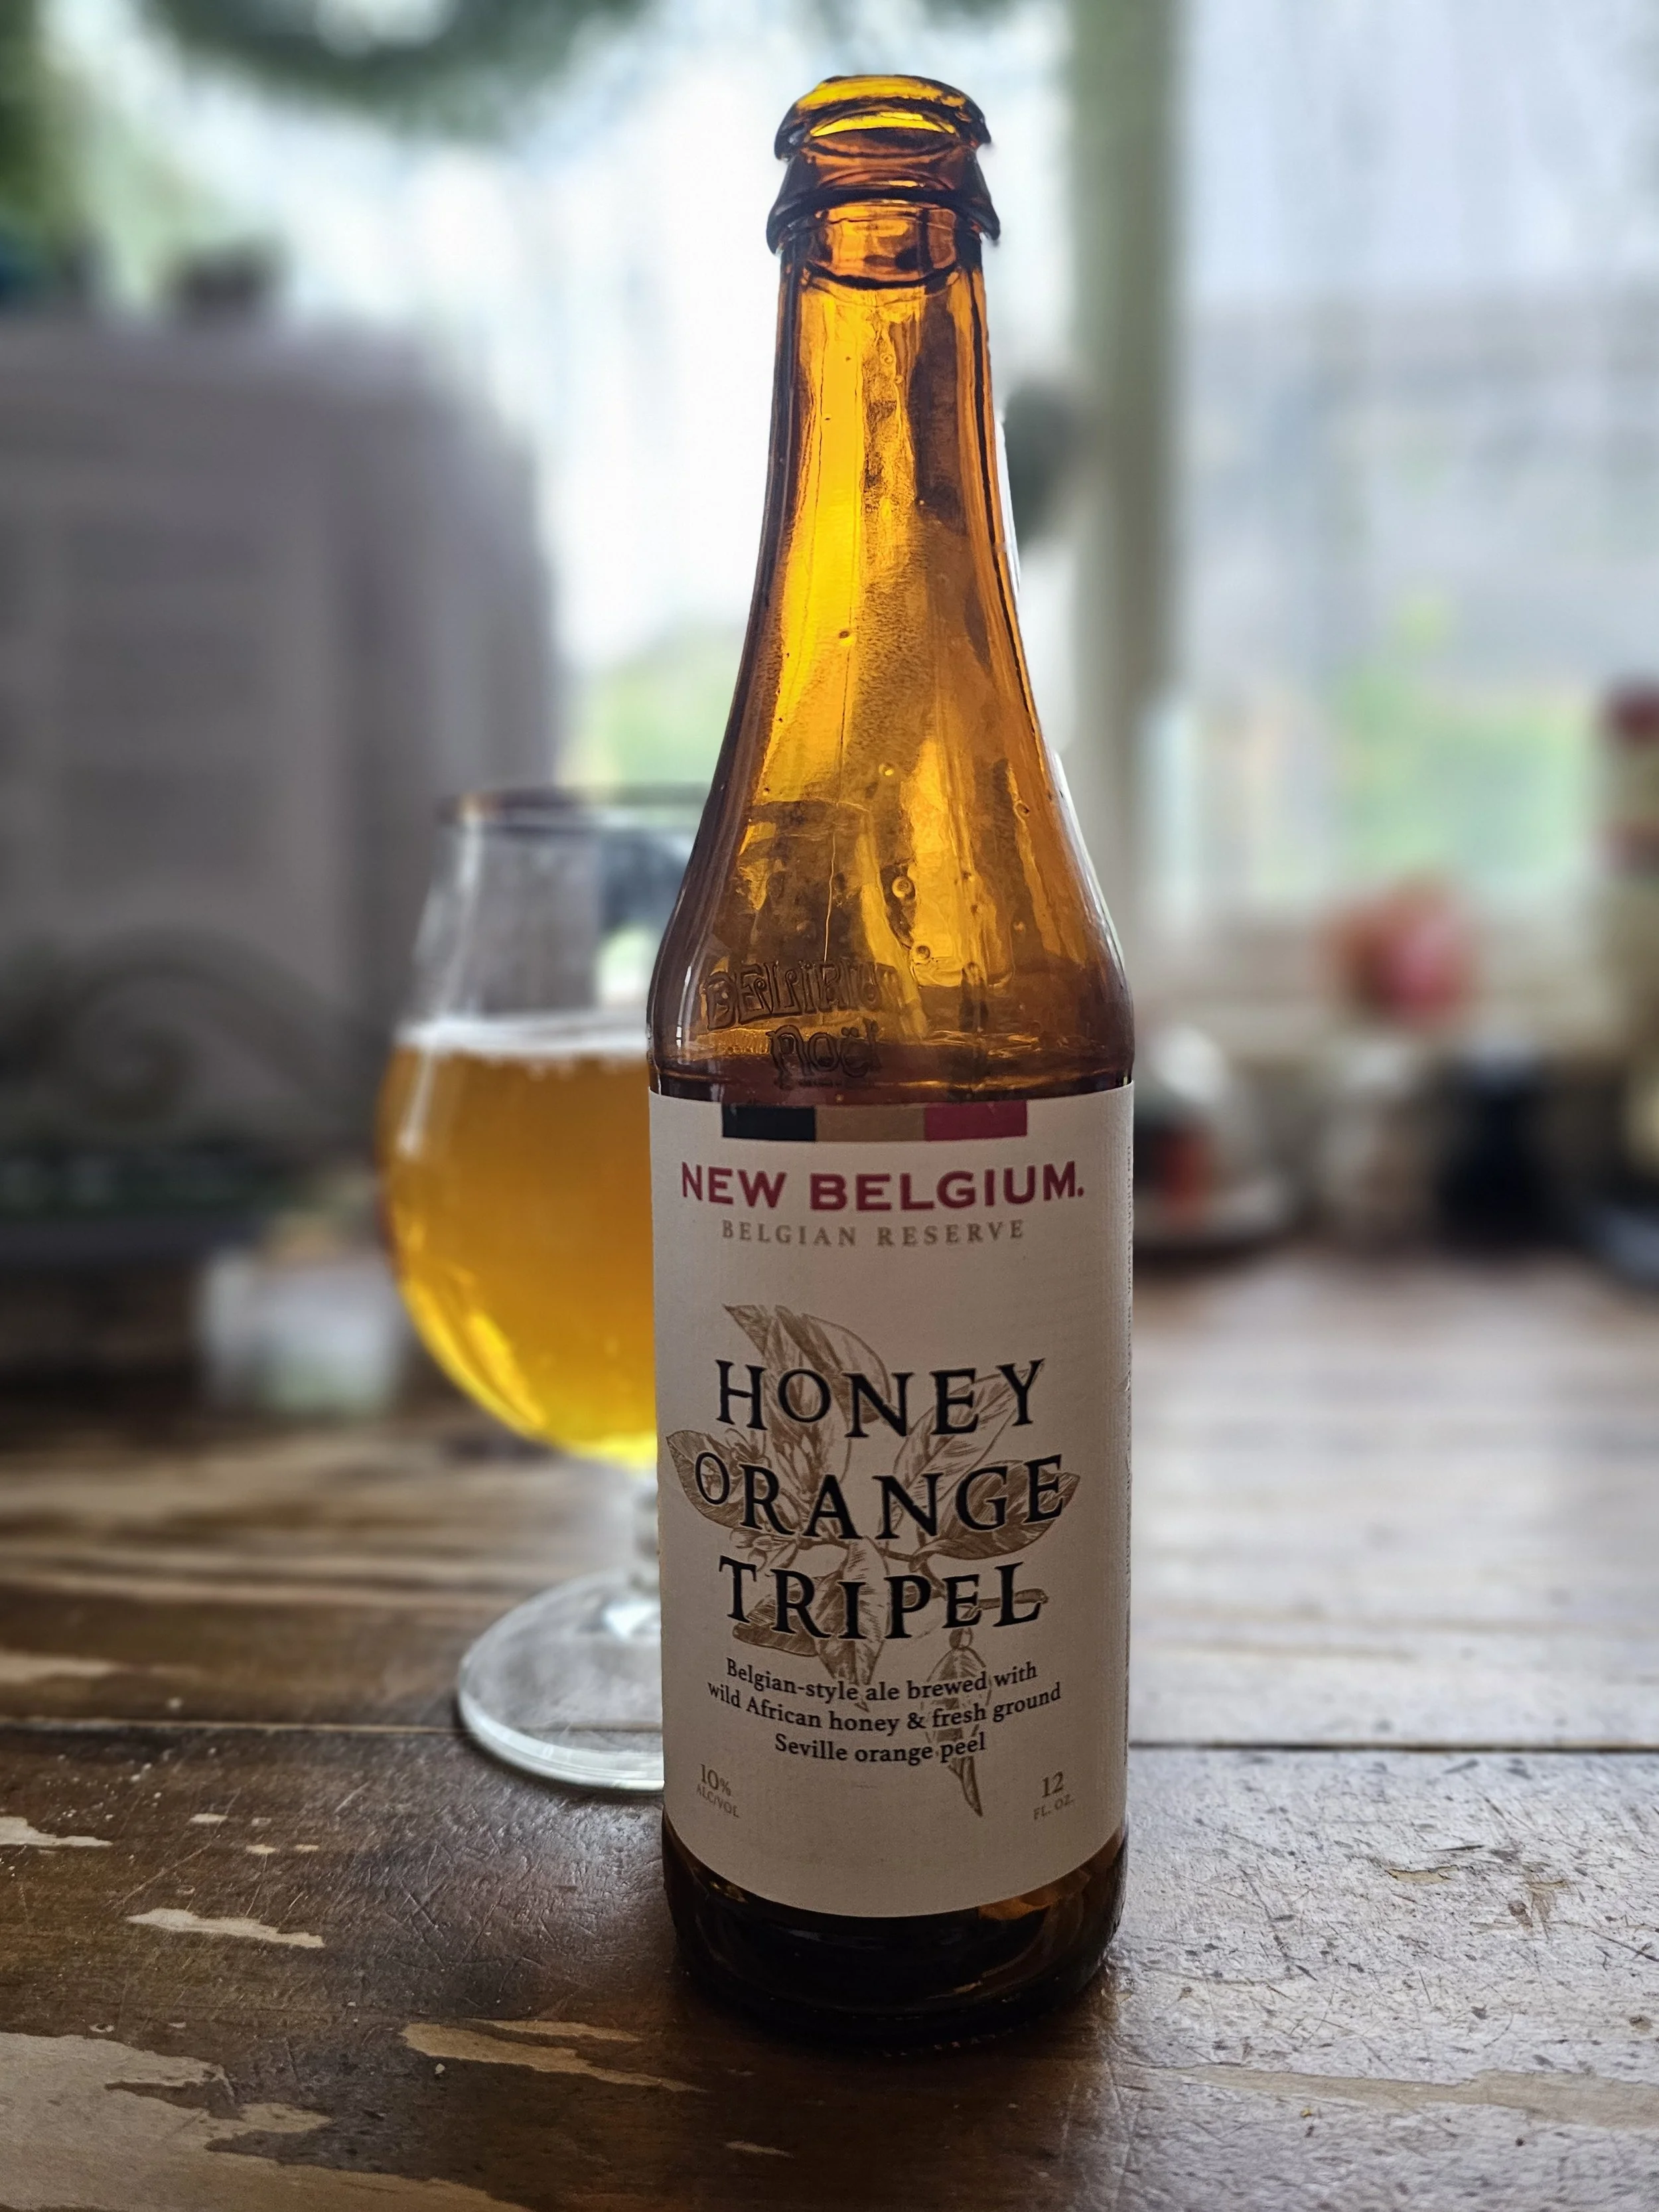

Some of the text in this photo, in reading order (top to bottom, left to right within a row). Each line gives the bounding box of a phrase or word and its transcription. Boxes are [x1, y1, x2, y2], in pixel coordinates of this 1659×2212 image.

[682, 1161, 788, 1209] NEW
[722, 1219, 1024, 1248] BELGIAN RESERVE
[715, 1358, 1046, 1438] HONEY
[694, 1453, 1063, 1540] ORANGE
[719, 1555, 1043, 1641] TRIPEL
[726, 1657, 1039, 1704] Belgian-style ale brewed with
[707, 1681, 1062, 1736] wild African honey & fresh ground
[774, 1731, 987, 1766] Seville orange peel
[700, 1763, 731, 1797] 10%
[1041, 1771, 1064, 1799] 12
